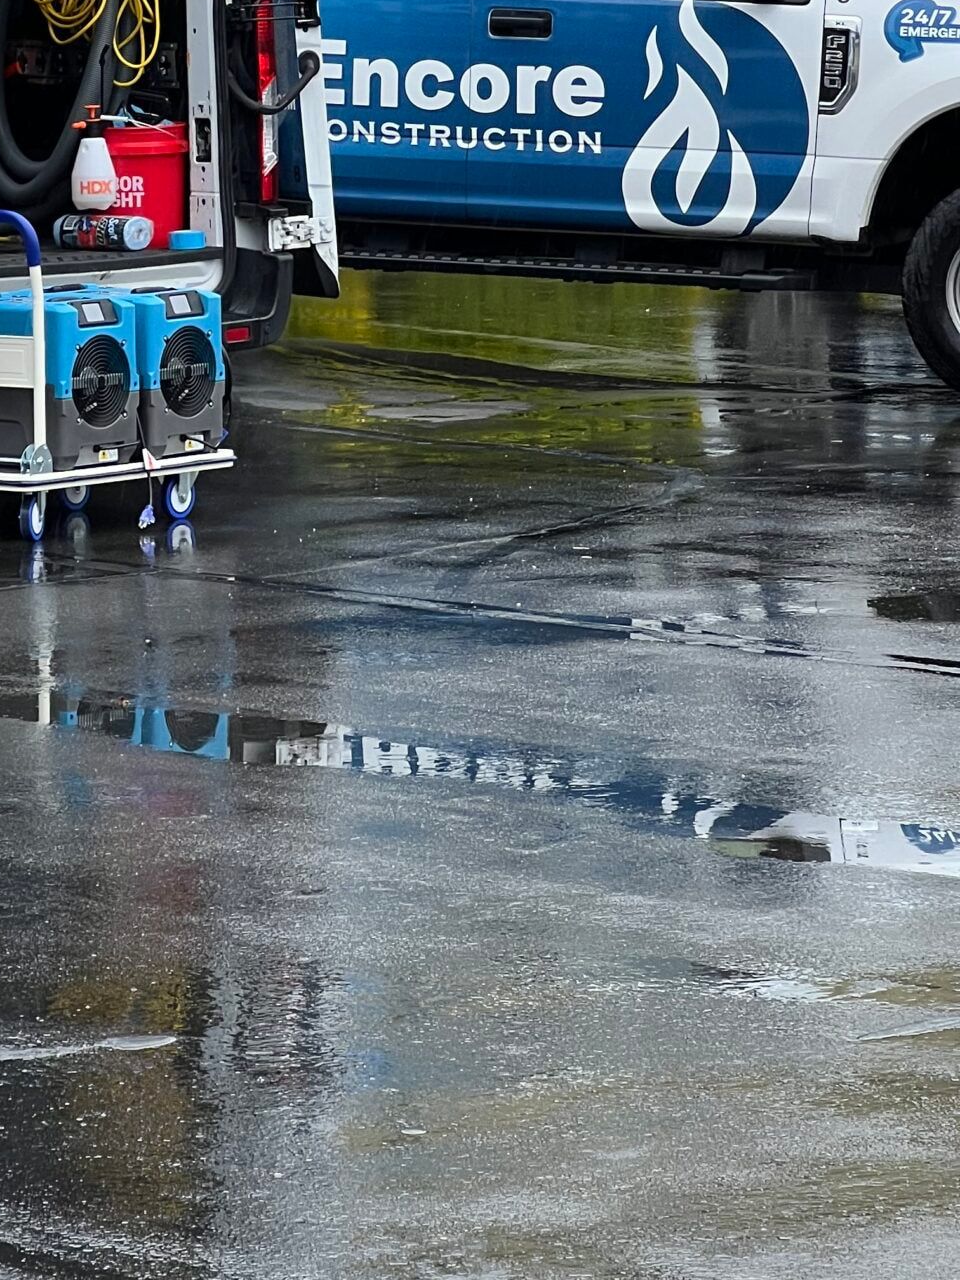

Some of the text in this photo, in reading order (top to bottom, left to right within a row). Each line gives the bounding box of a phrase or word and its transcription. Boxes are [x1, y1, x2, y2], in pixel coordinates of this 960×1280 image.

[900, 8, 952, 26] 24/7
[327, 118, 603, 155] ONSTRUCTION
[80, 180, 113, 196] HDX
